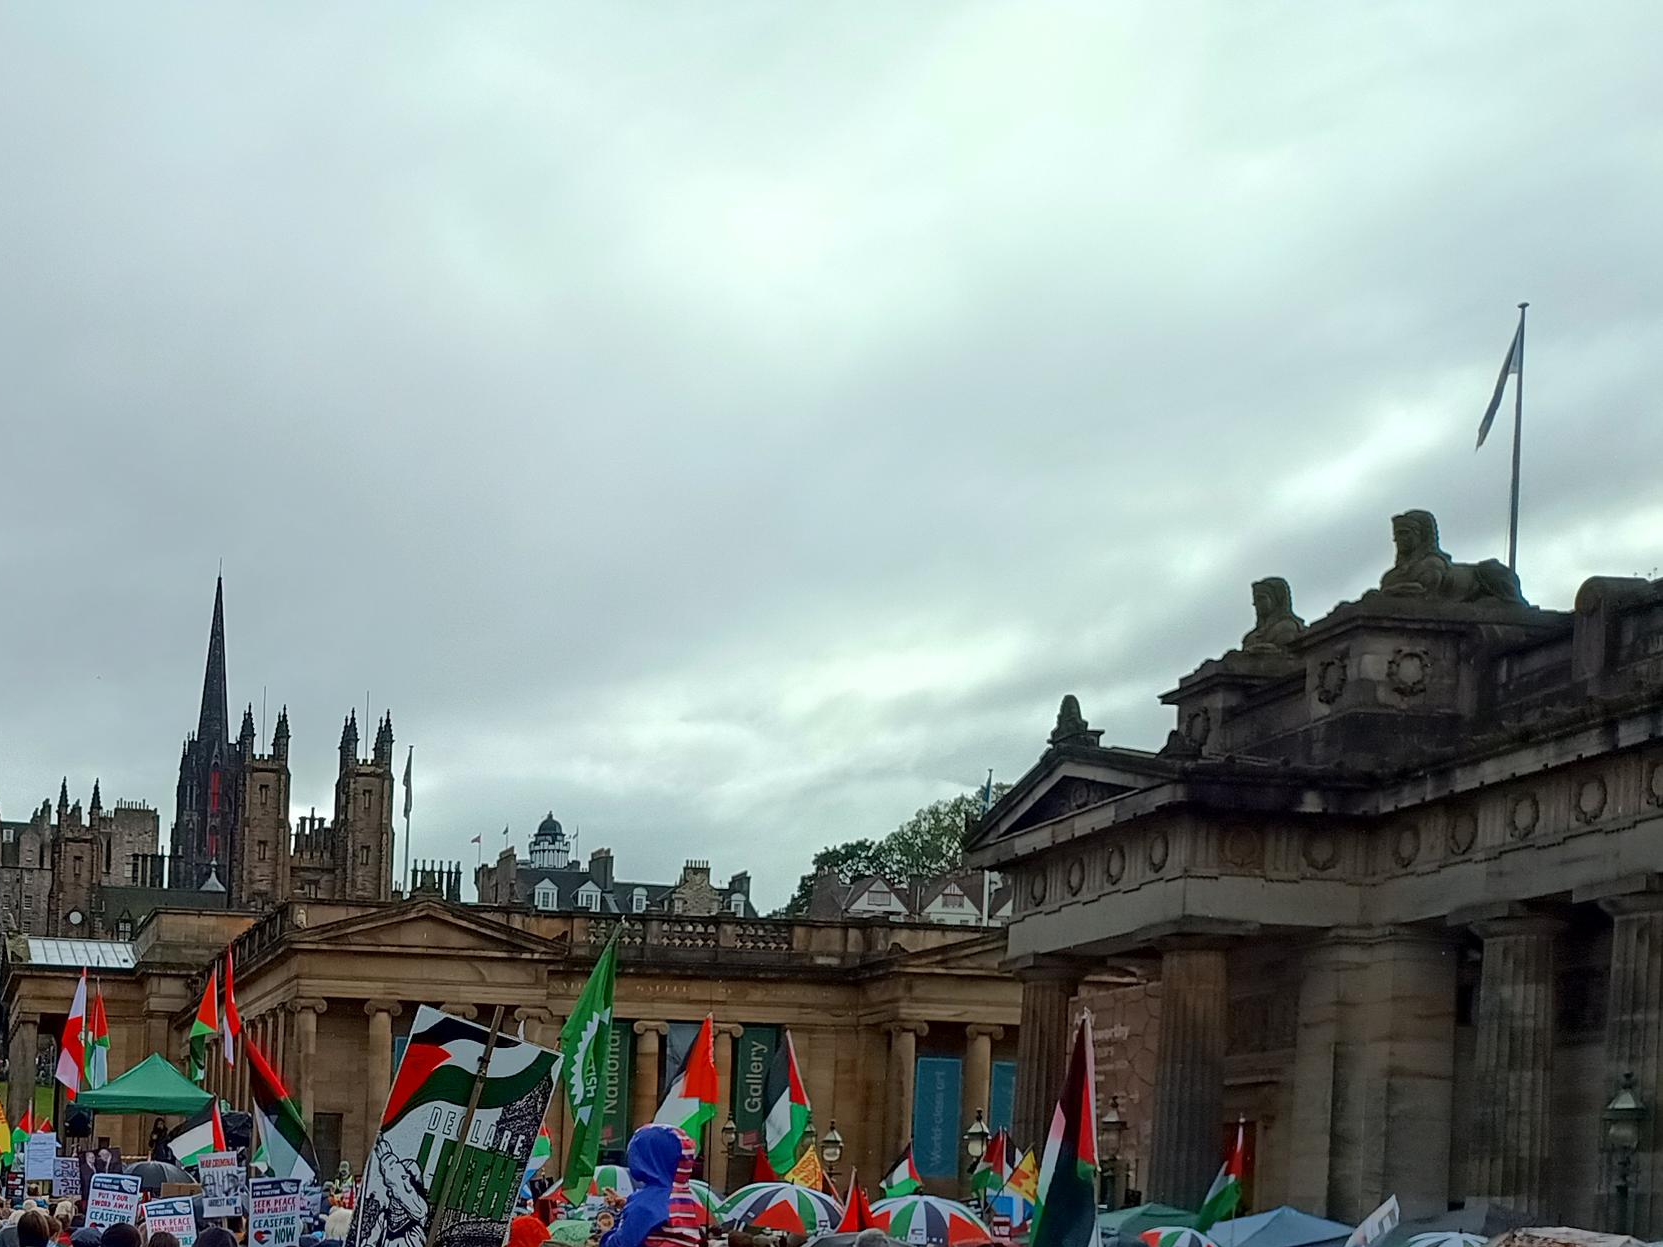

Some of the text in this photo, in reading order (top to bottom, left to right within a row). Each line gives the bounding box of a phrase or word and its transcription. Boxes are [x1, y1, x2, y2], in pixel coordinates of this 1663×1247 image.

[745, 1041, 768, 1113] Gallery
[112, 1193, 129, 1202] YOUR
[253, 1197, 296, 1208] SEEK PEACE
[113, 1201, 134, 1211] AWAY
[89, 1210, 131, 1223] CEASEFIRE
[253, 1216, 296, 1229] CEASEFIRE
[274, 1227, 296, 1244] NOW
